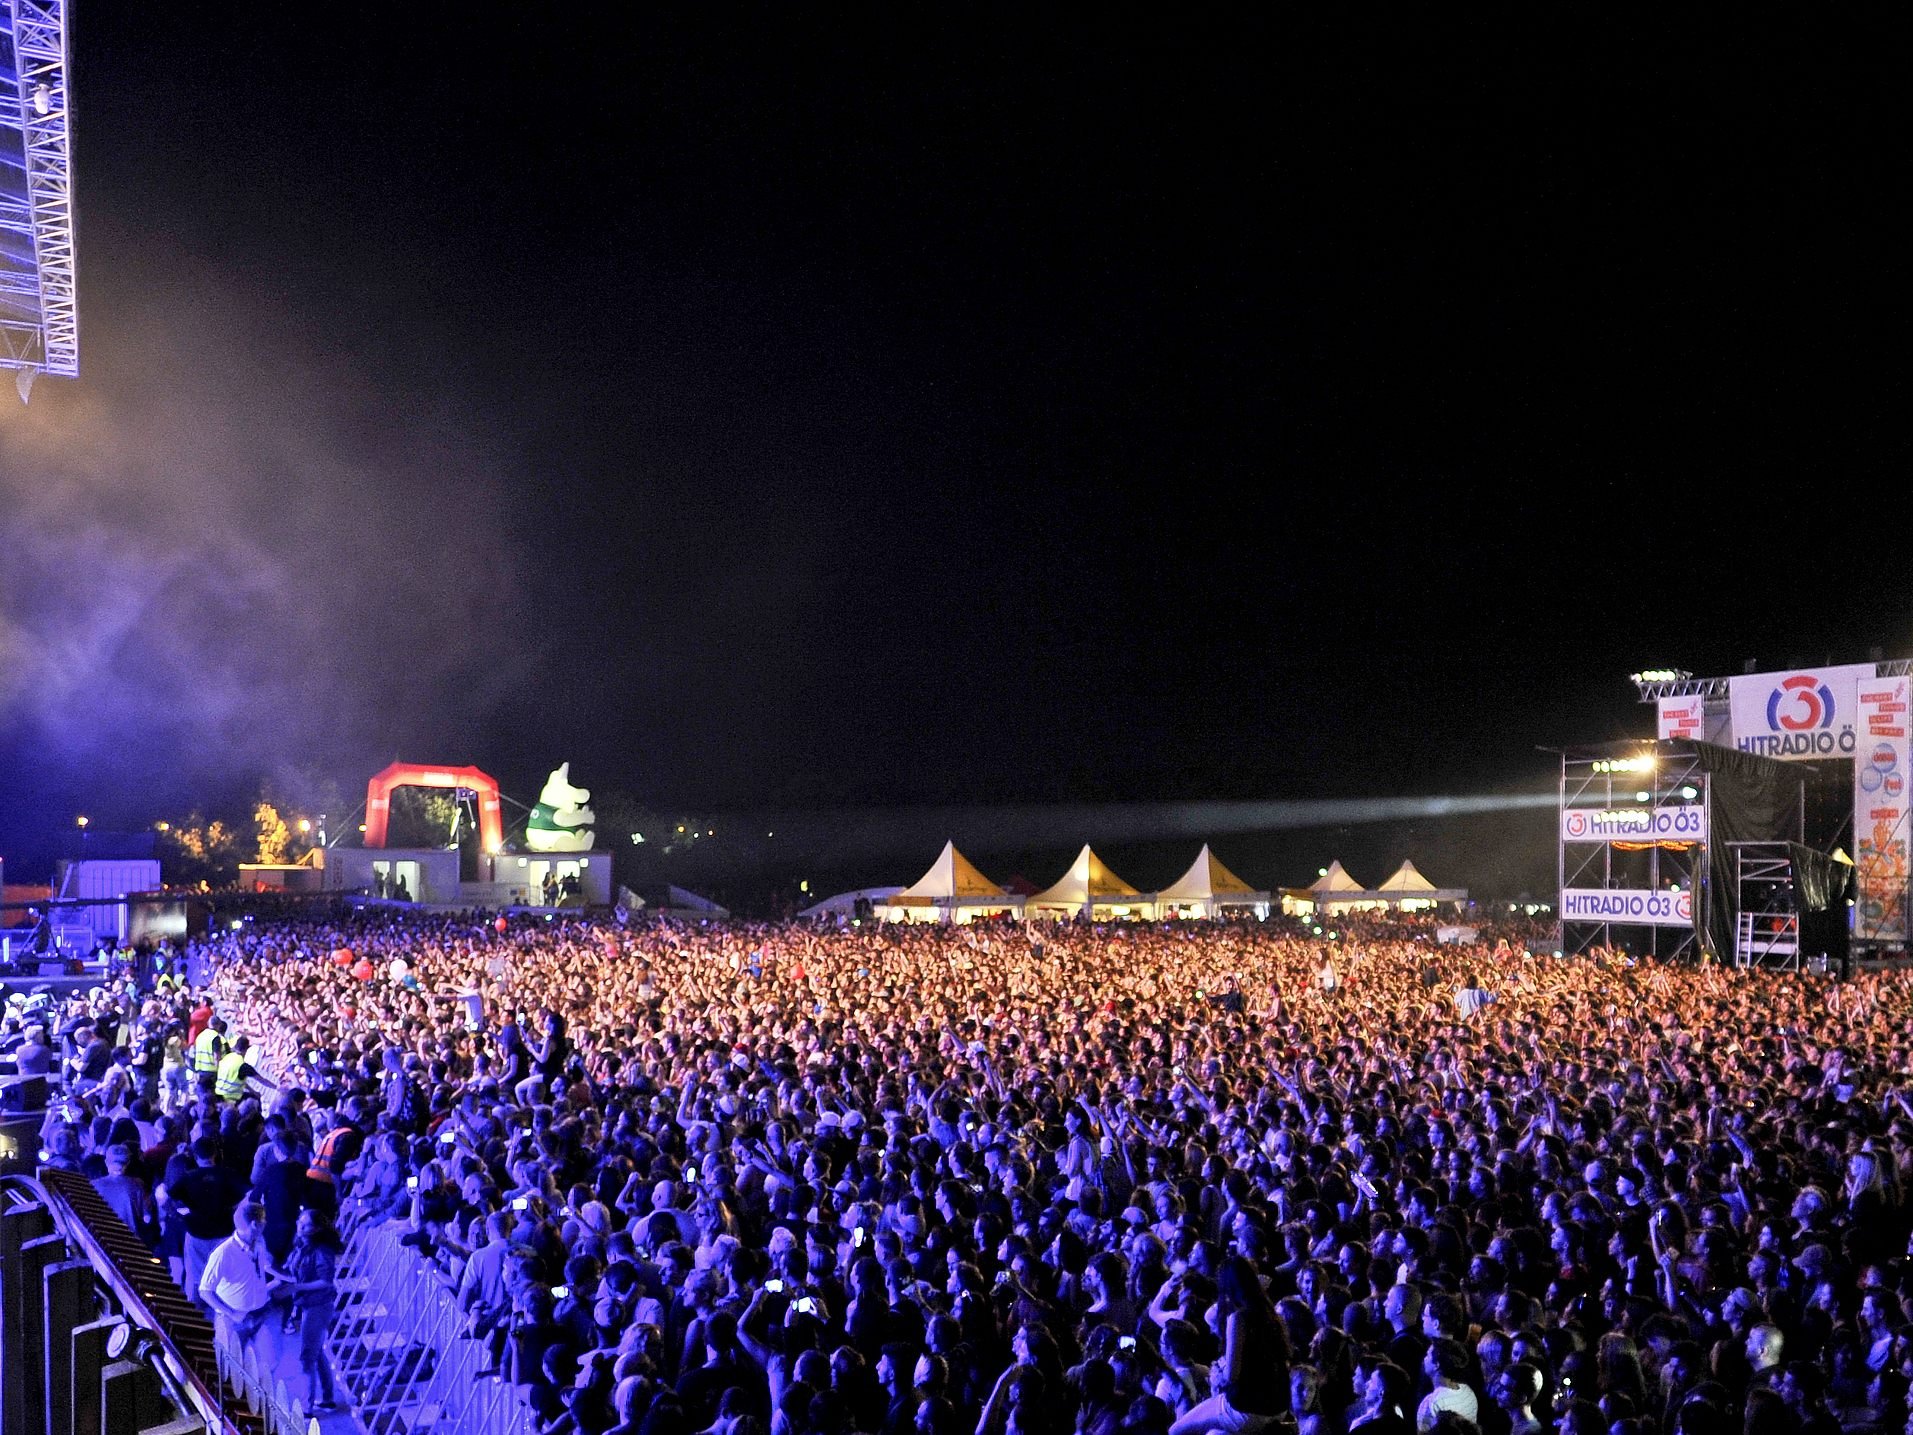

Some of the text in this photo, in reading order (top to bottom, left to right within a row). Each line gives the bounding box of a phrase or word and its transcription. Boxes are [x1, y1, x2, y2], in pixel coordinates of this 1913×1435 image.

[1737, 724, 1856, 757] HITRADIO Ö
[1675, 806, 1700, 833] Ö3
[1565, 895, 1644, 916] HITRADIO
[1647, 890, 1671, 917] Ö3
